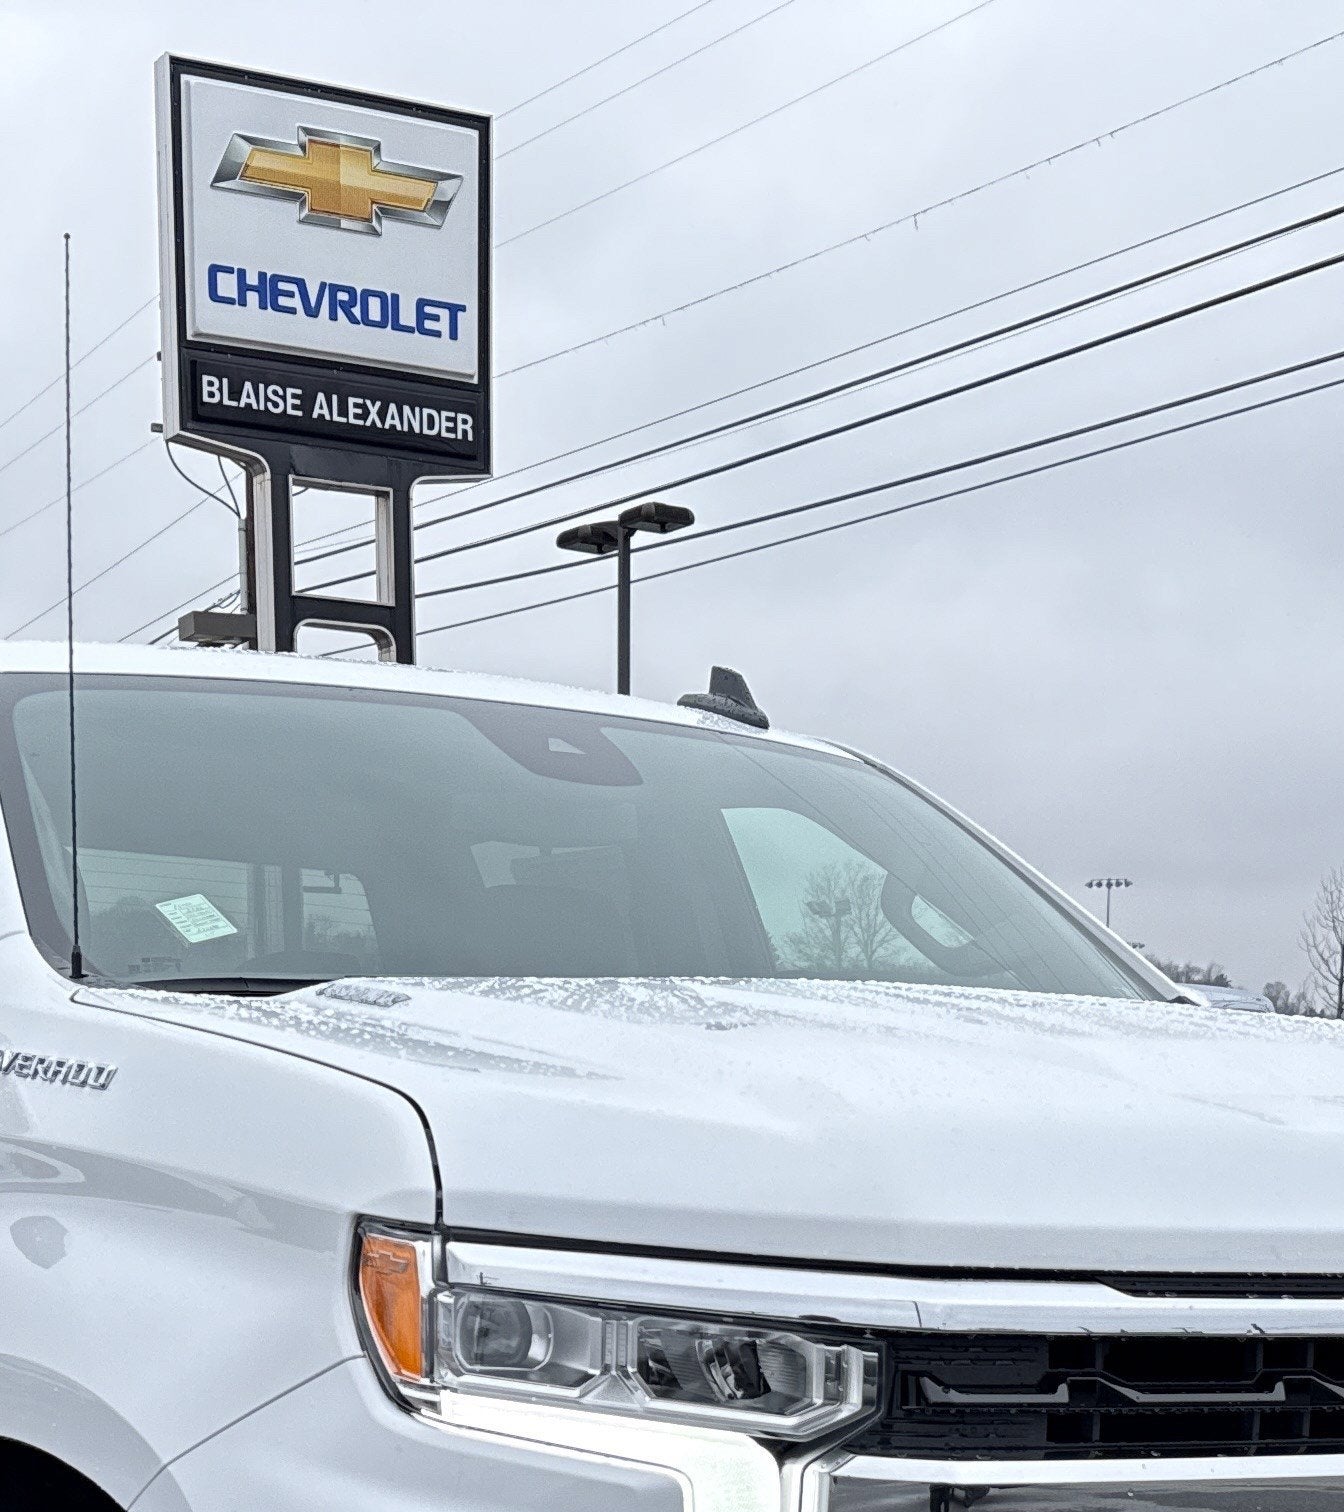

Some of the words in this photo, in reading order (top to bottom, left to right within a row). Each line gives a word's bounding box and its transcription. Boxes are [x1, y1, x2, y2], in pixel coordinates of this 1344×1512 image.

[208, 263, 467, 341] CHEVROLET
[202, 375, 303, 417] BLAISE
[312, 392, 474, 442] ALEXANDER
